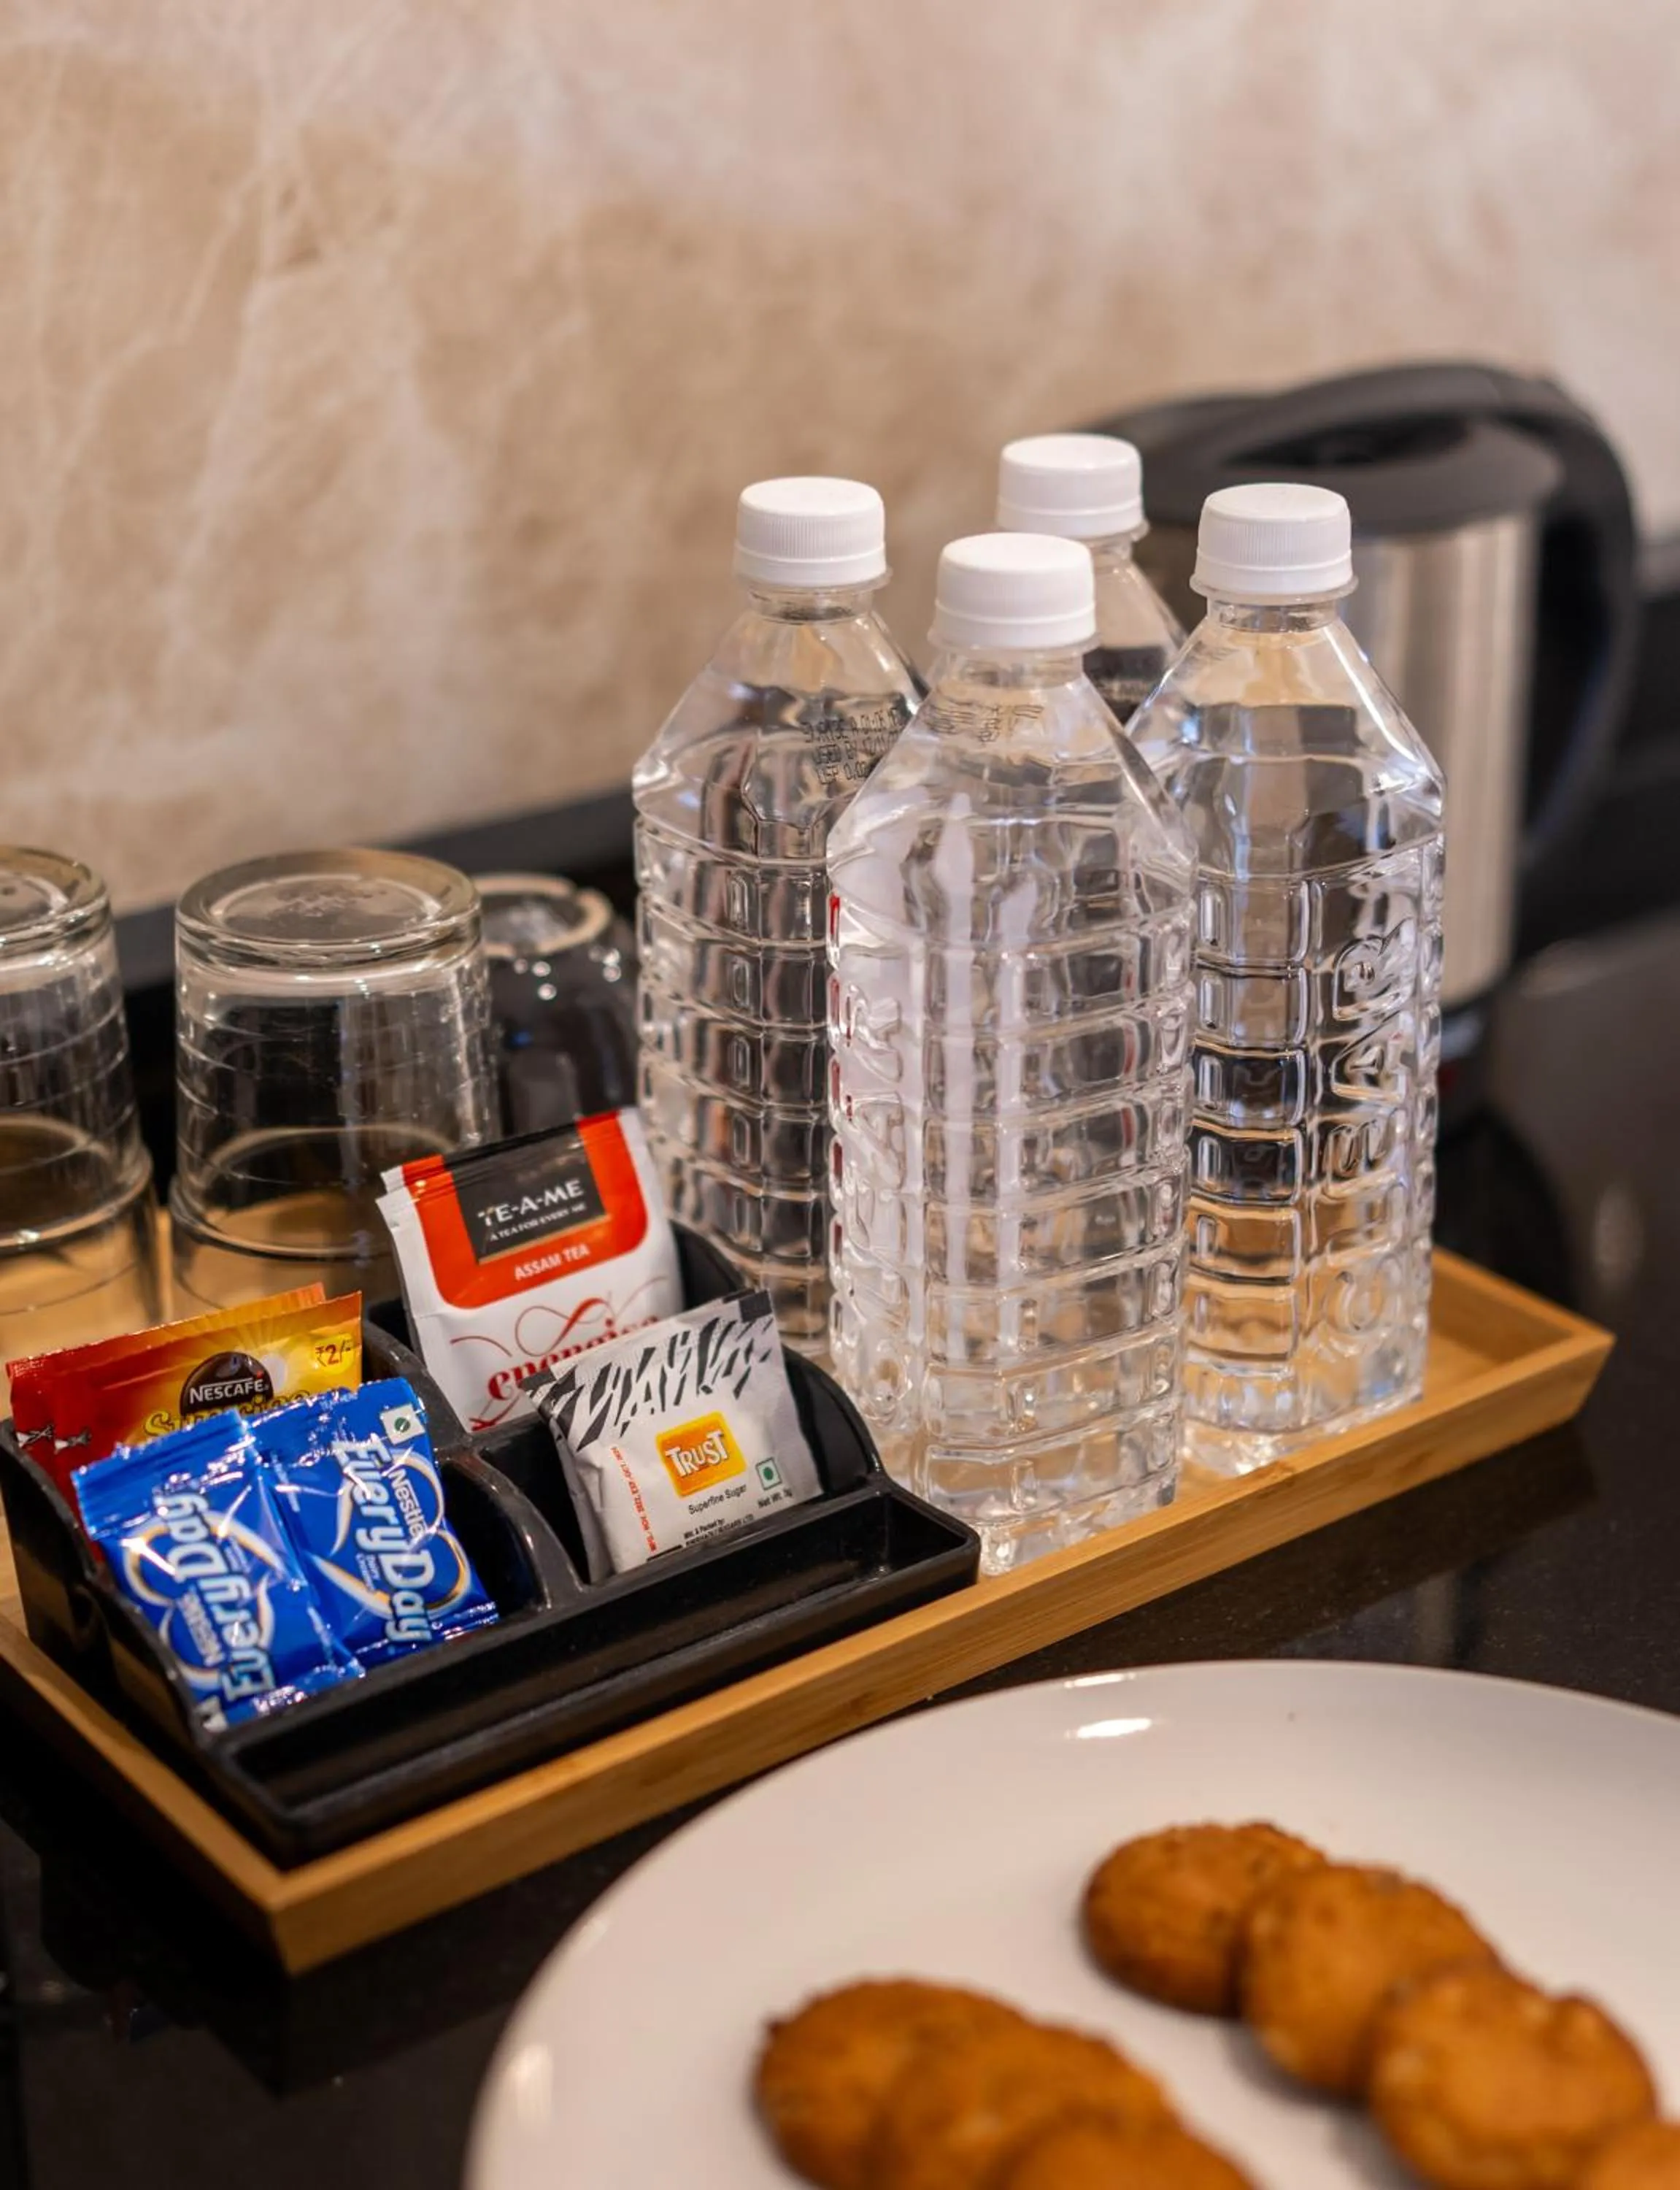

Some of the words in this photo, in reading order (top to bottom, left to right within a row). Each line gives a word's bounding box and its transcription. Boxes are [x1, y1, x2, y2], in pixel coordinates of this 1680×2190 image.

[477, 1178, 585, 1228] TE-A-ME
[514, 1251, 562, 1281] ASSAM
[563, 1244, 590, 1262] TEA
[665, 1429, 730, 1478] TRUST
